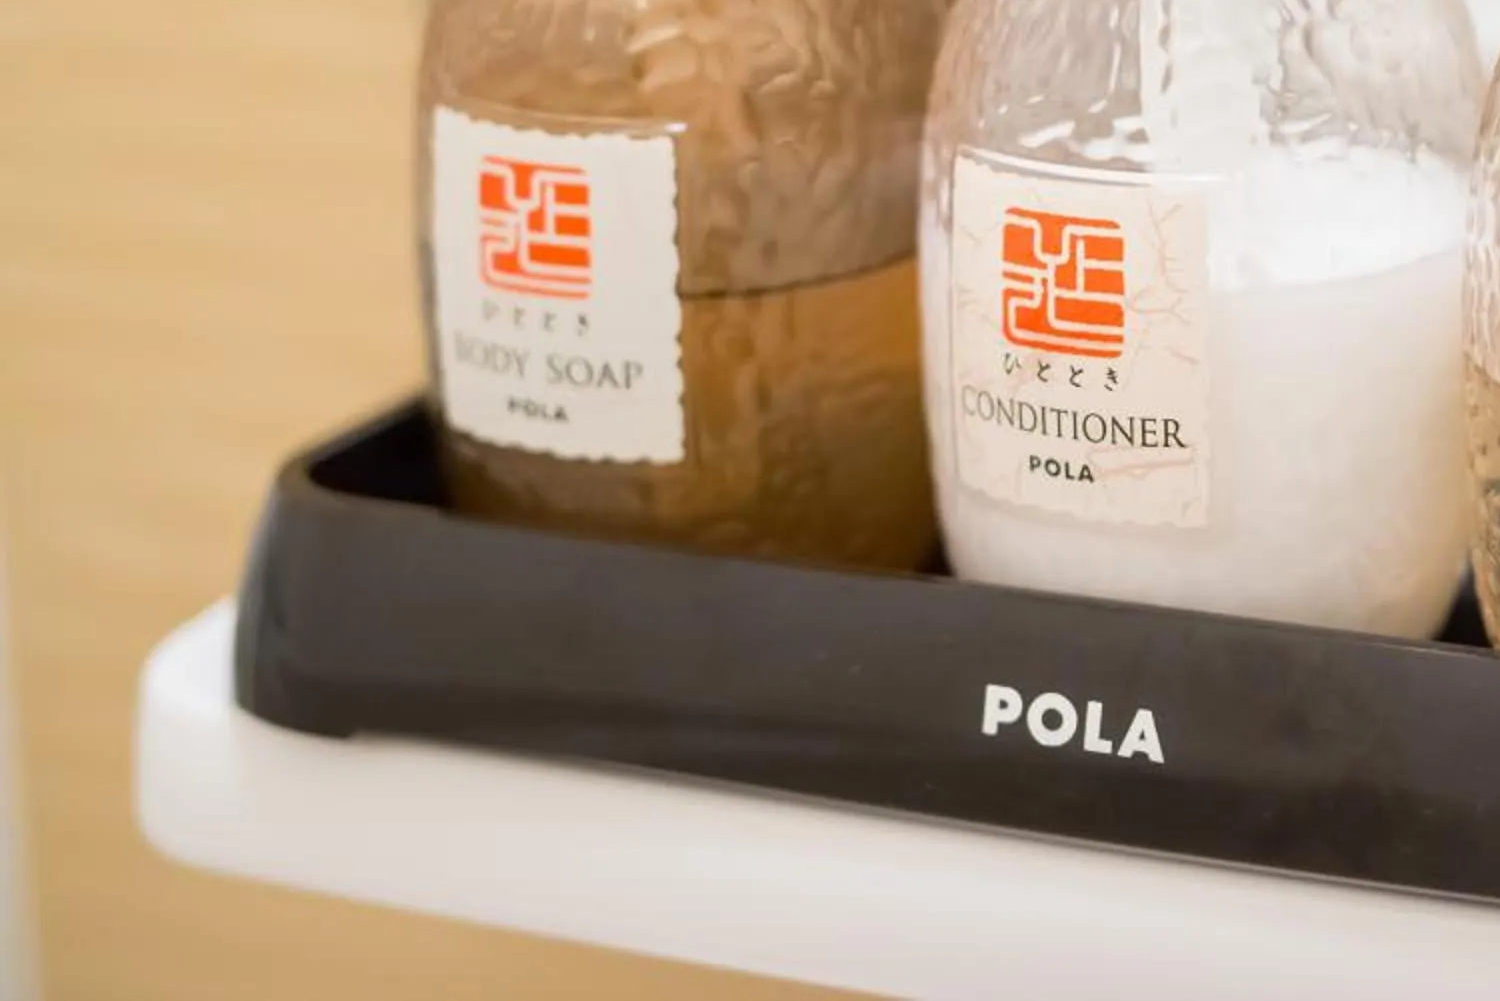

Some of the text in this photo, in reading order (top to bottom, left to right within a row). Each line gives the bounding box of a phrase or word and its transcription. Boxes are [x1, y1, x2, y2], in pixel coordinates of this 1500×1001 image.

[545, 352, 645, 390] SOAP
[1003, 352, 1120, 392] ひととき
[961, 384, 1187, 449] CONDITIONER
[1028, 454, 1095, 483] POLA
[981, 683, 1165, 764] POLA
